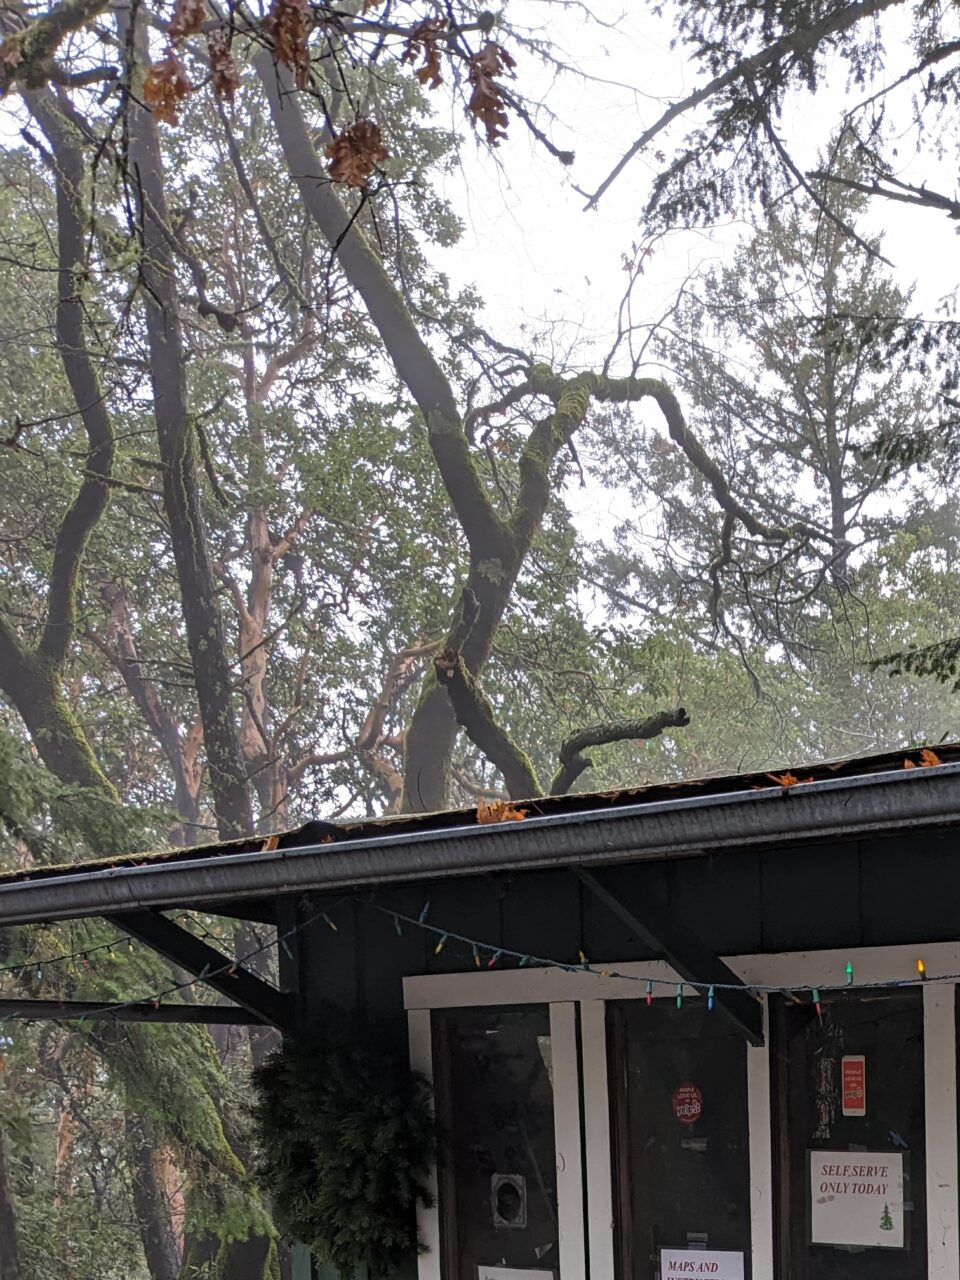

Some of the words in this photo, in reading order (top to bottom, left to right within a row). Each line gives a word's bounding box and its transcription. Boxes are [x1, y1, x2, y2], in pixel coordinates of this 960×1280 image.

[852, 1166, 888, 1178] SERVE
[820, 1182, 850, 1194] ONLY
[852, 1183, 888, 1195] TODAY
[668, 1260, 695, 1272] MAPS
[696, 1262, 718, 1272] AND
